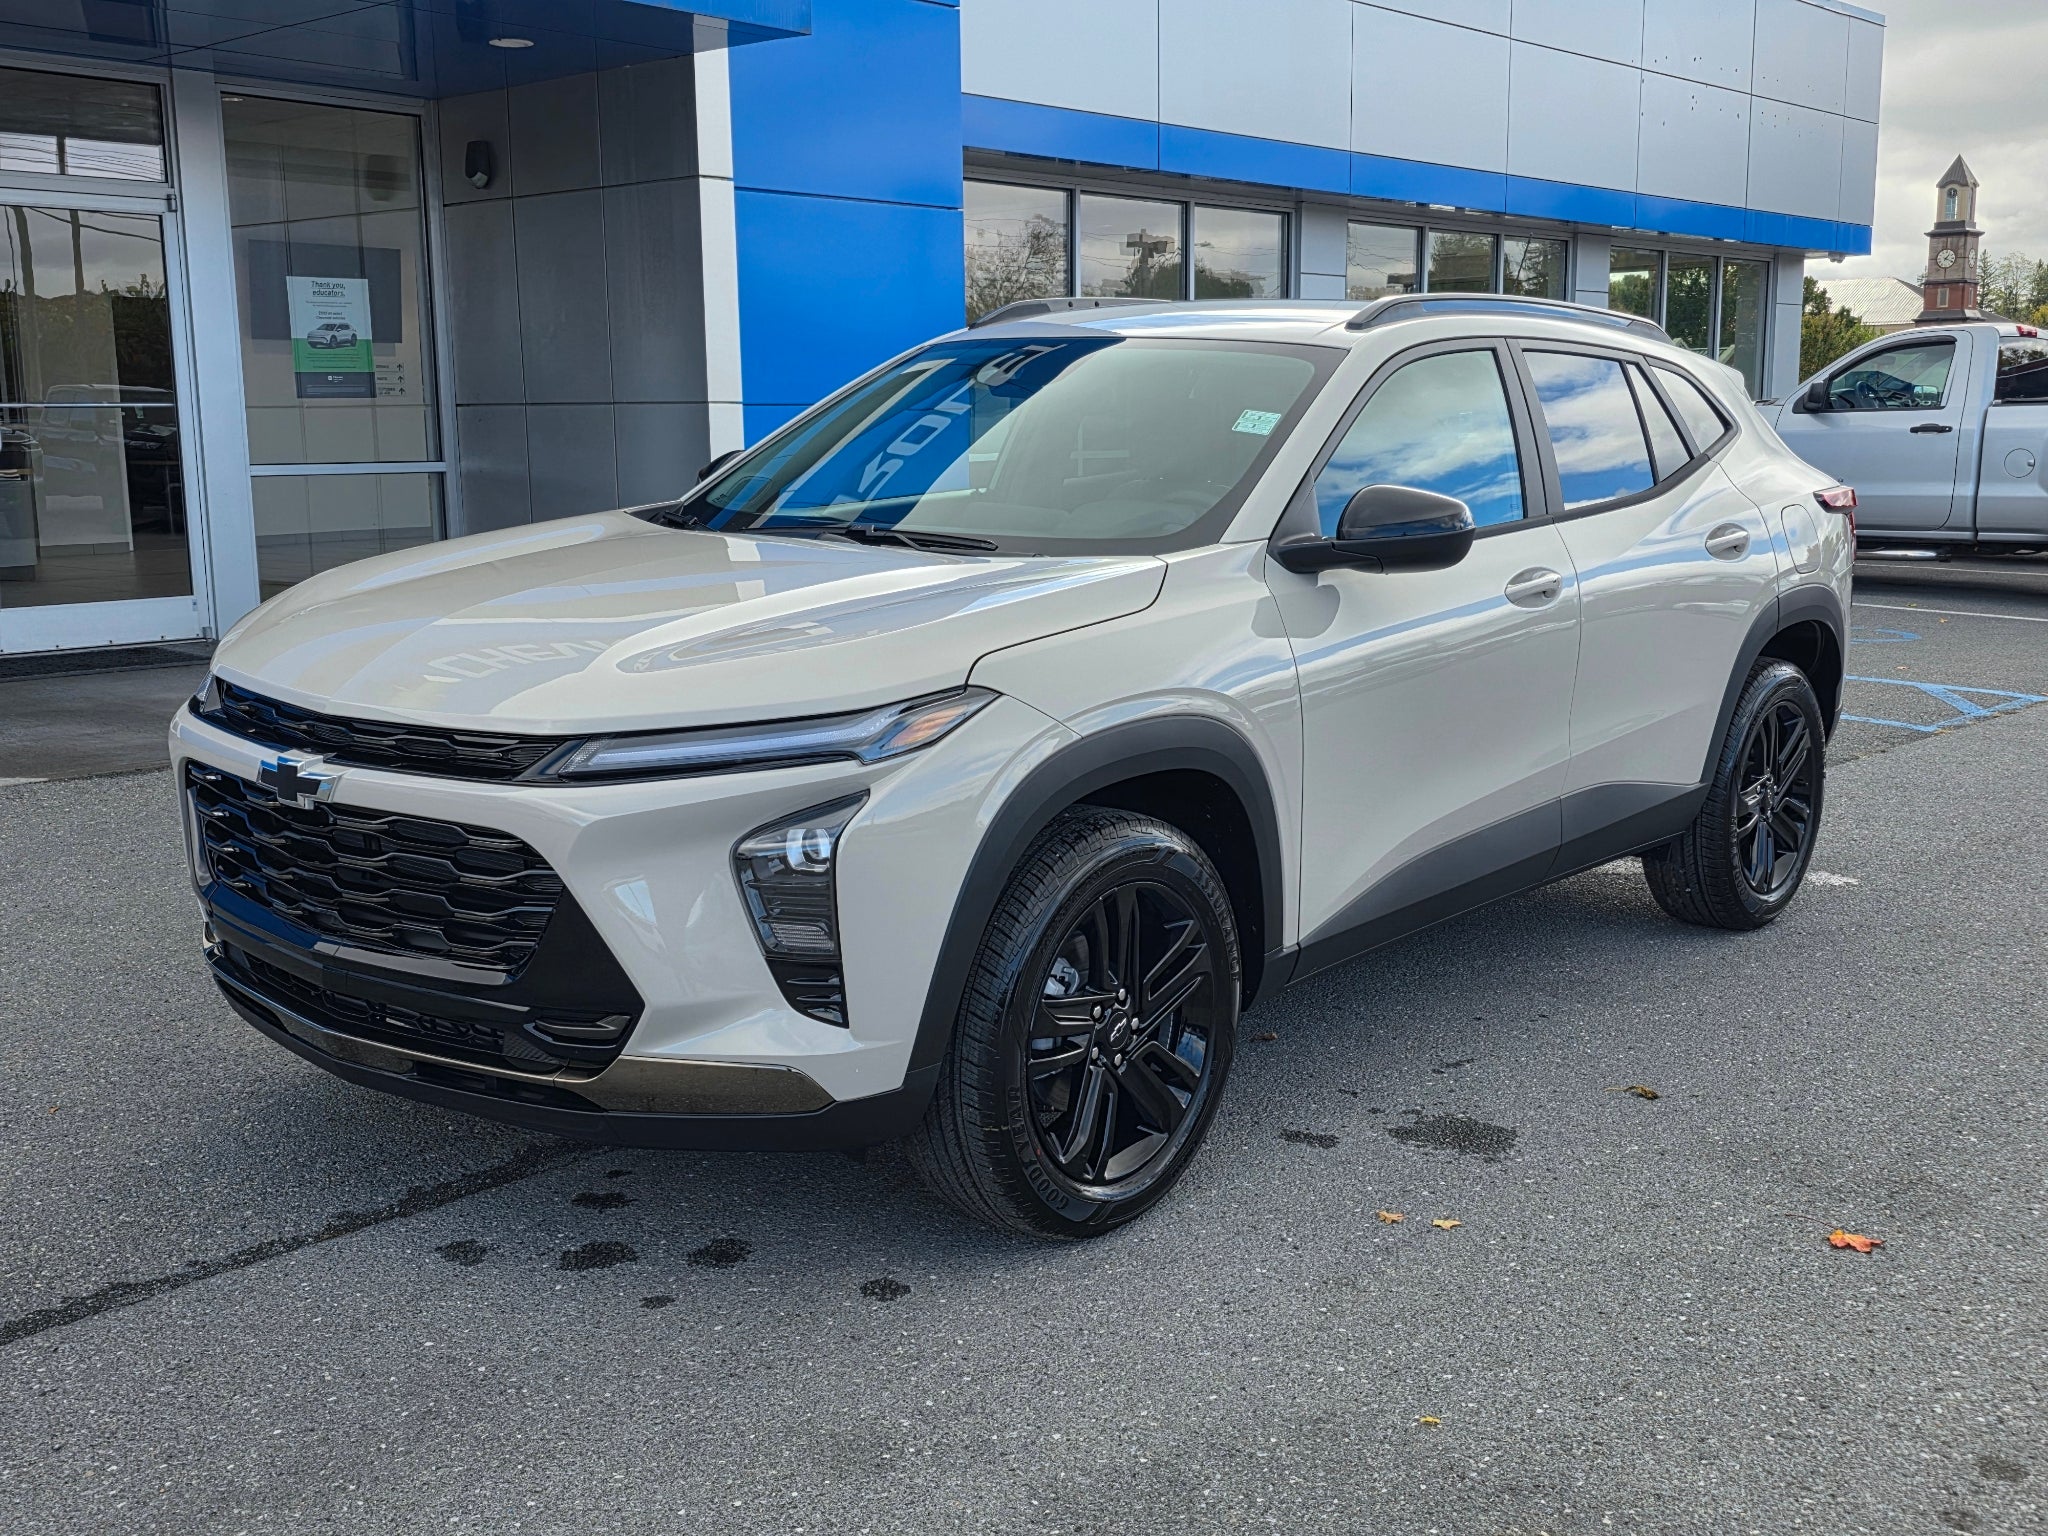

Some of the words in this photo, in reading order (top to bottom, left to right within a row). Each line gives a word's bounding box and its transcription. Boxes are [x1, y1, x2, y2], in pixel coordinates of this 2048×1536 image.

[311, 280, 331, 288] Thank
[332, 282, 346, 290] you,
[312, 289, 346, 297] educators.
